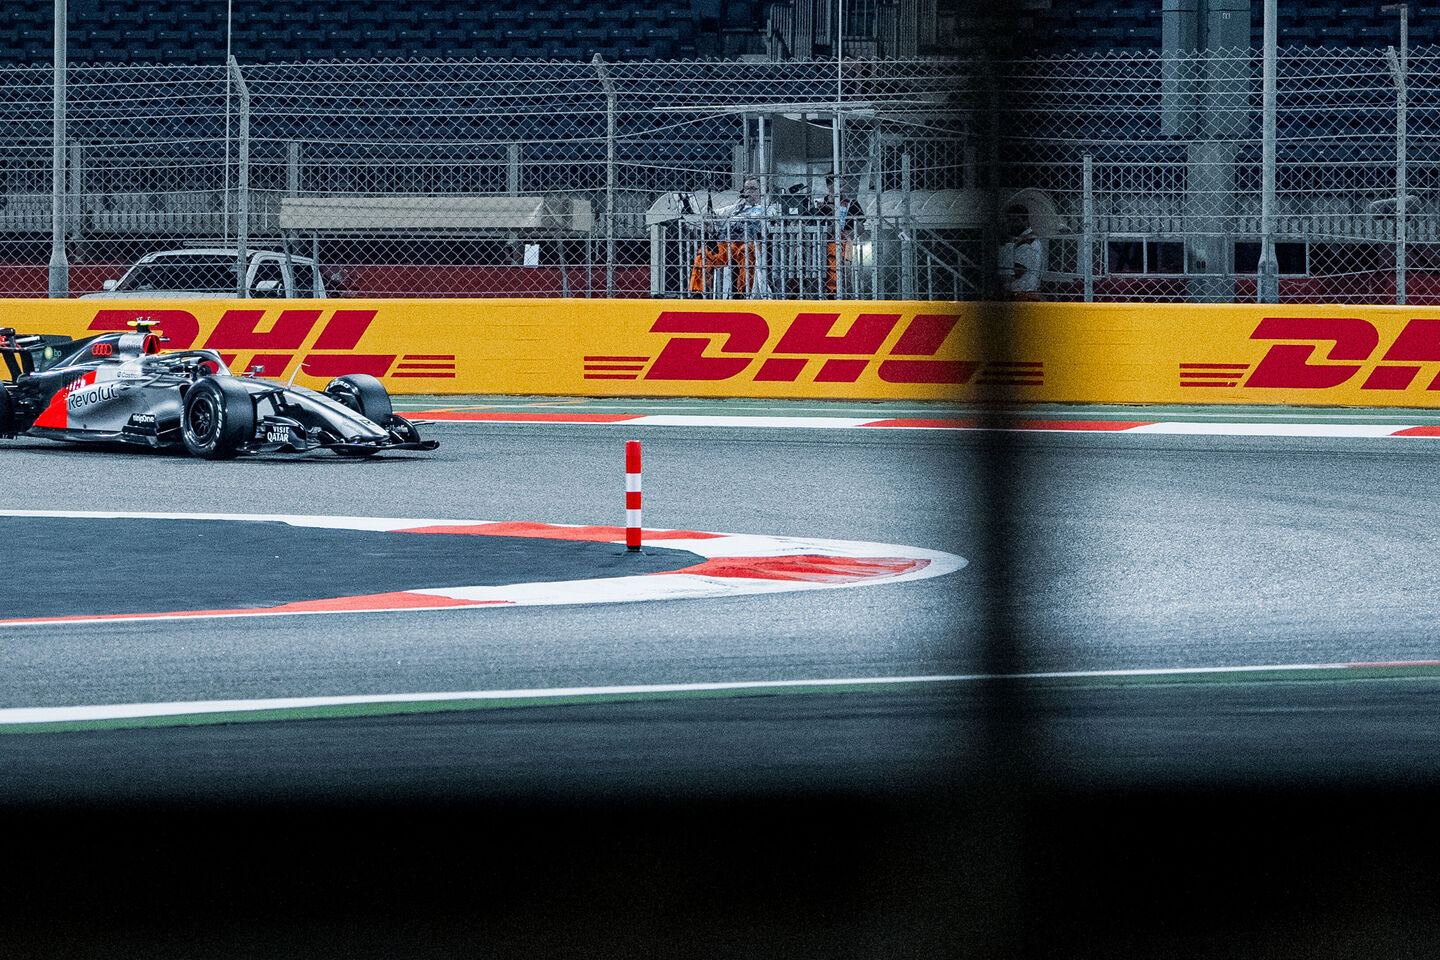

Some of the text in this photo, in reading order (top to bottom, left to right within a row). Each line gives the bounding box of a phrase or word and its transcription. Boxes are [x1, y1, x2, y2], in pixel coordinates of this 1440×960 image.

[87, 309, 397, 378] DHL
[644, 311, 982, 385] DHL
[53, 349, 62, 358] bp
[67, 384, 120, 410] Revolut
[266, 431, 289, 443] QATAR
[272, 425, 290, 434] VISIT
